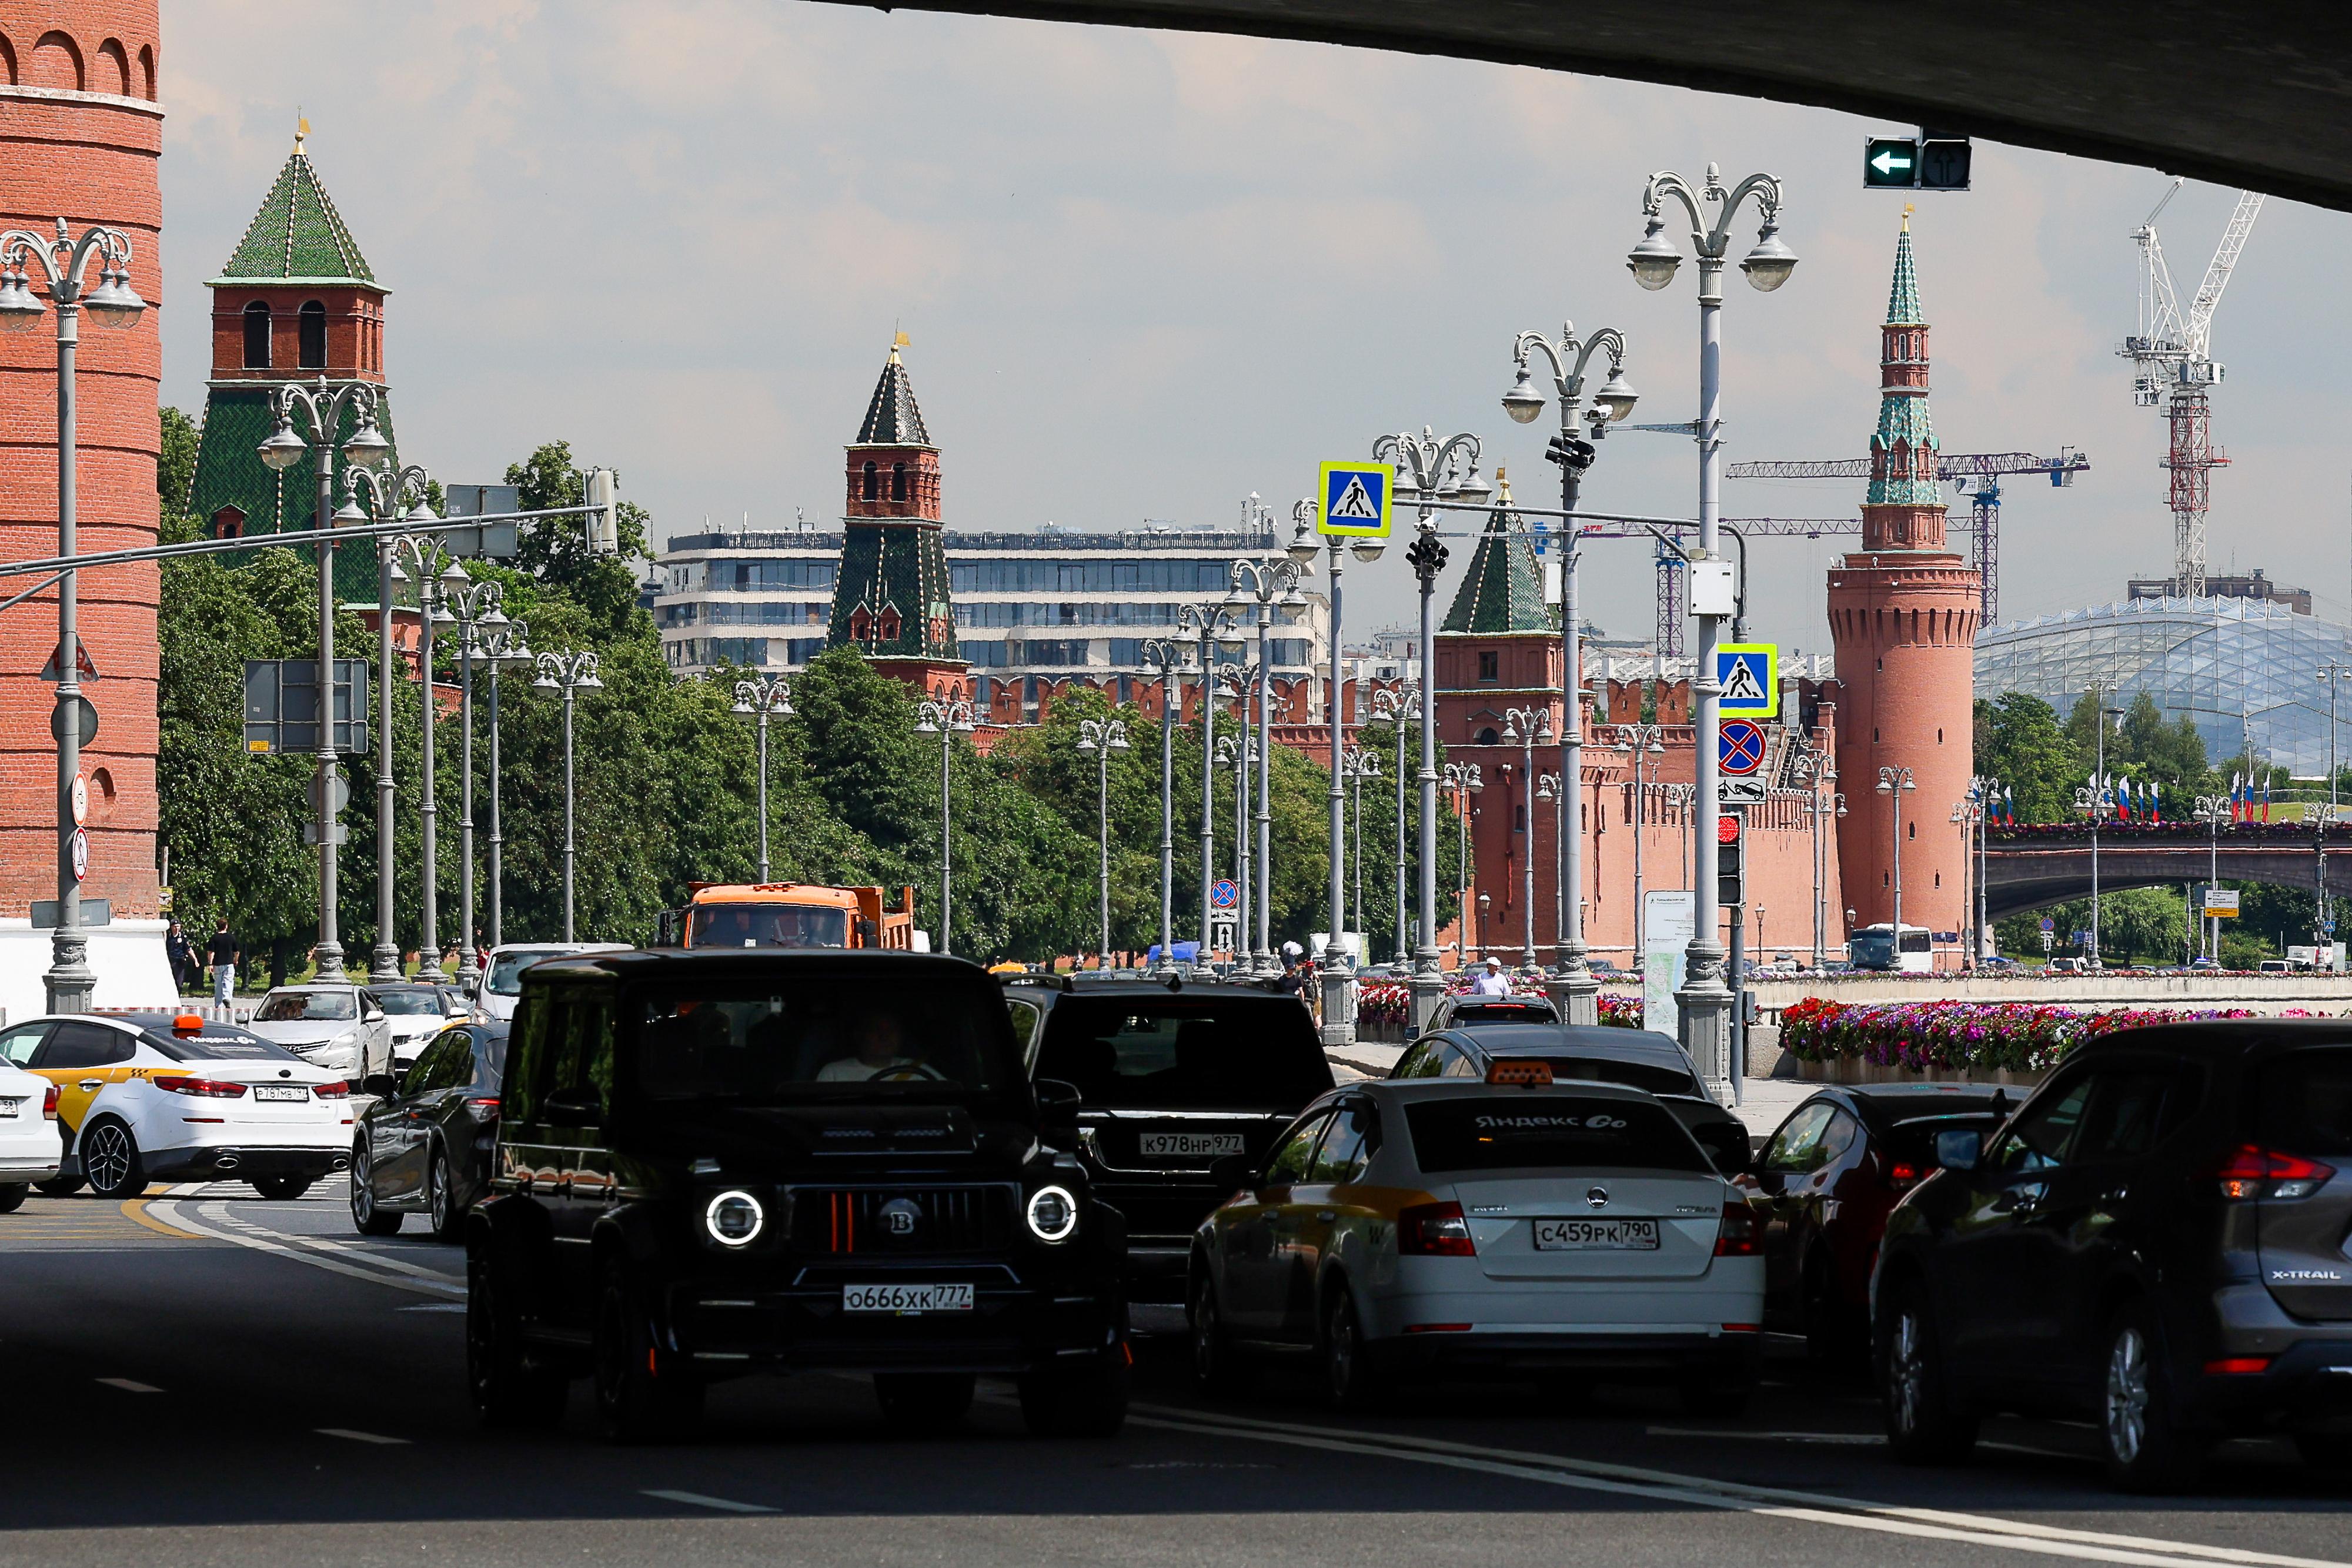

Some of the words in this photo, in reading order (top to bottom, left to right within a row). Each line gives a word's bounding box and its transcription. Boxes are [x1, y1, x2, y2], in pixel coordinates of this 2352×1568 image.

[1475, 1116, 1579, 1127] Яндекс
[1585, 1115, 1627, 1128] Go
[1146, 1136, 1211, 1152] К978НР
[1214, 1136, 1240, 1148] 977
[1541, 1223, 1618, 1242] С459РК
[1622, 1222, 1652, 1236] 790
[2272, 1271, 2341, 1279] X-TRAIL
[850, 1287, 931, 1308] О666ХК
[936, 1286, 967, 1302] 777
